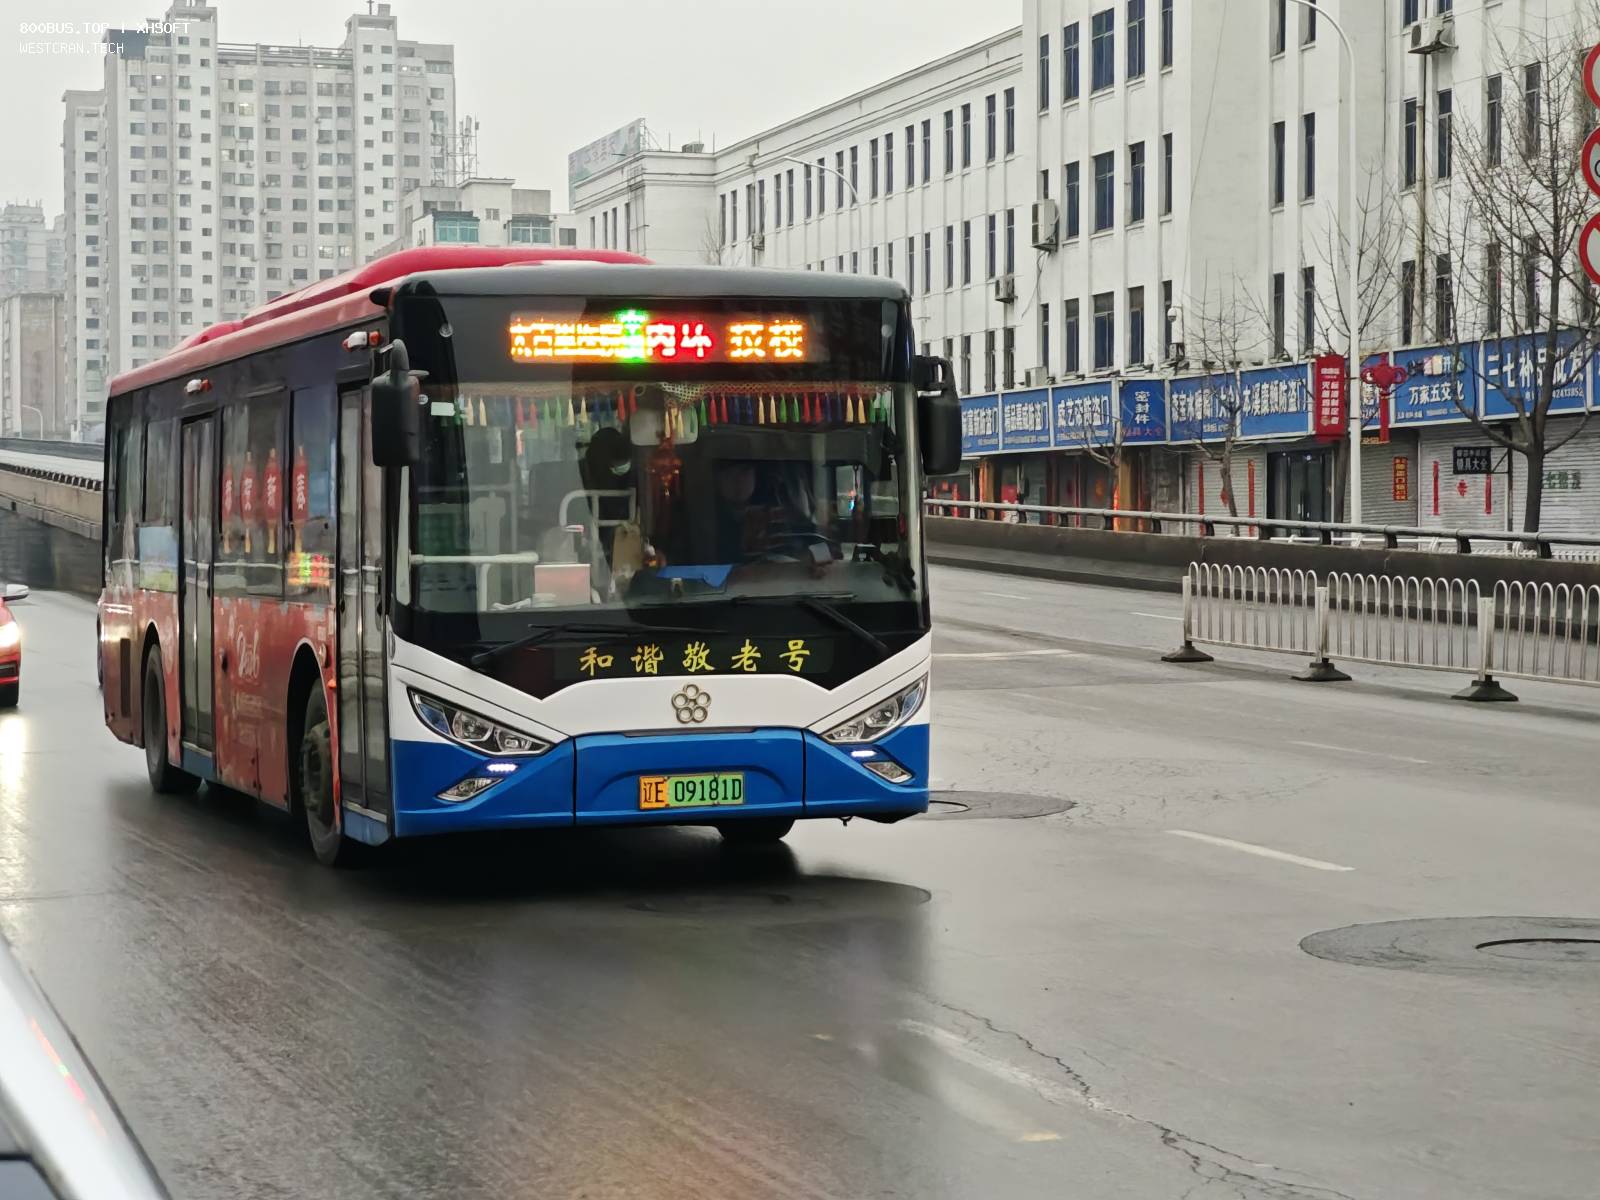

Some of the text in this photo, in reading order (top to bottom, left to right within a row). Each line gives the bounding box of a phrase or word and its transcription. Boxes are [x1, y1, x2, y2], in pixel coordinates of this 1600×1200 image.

[1134, 390, 1150, 425] 密封件
[579, 638, 811, 676] 和谐敬老号
[674, 777, 742, 803] 09181D
